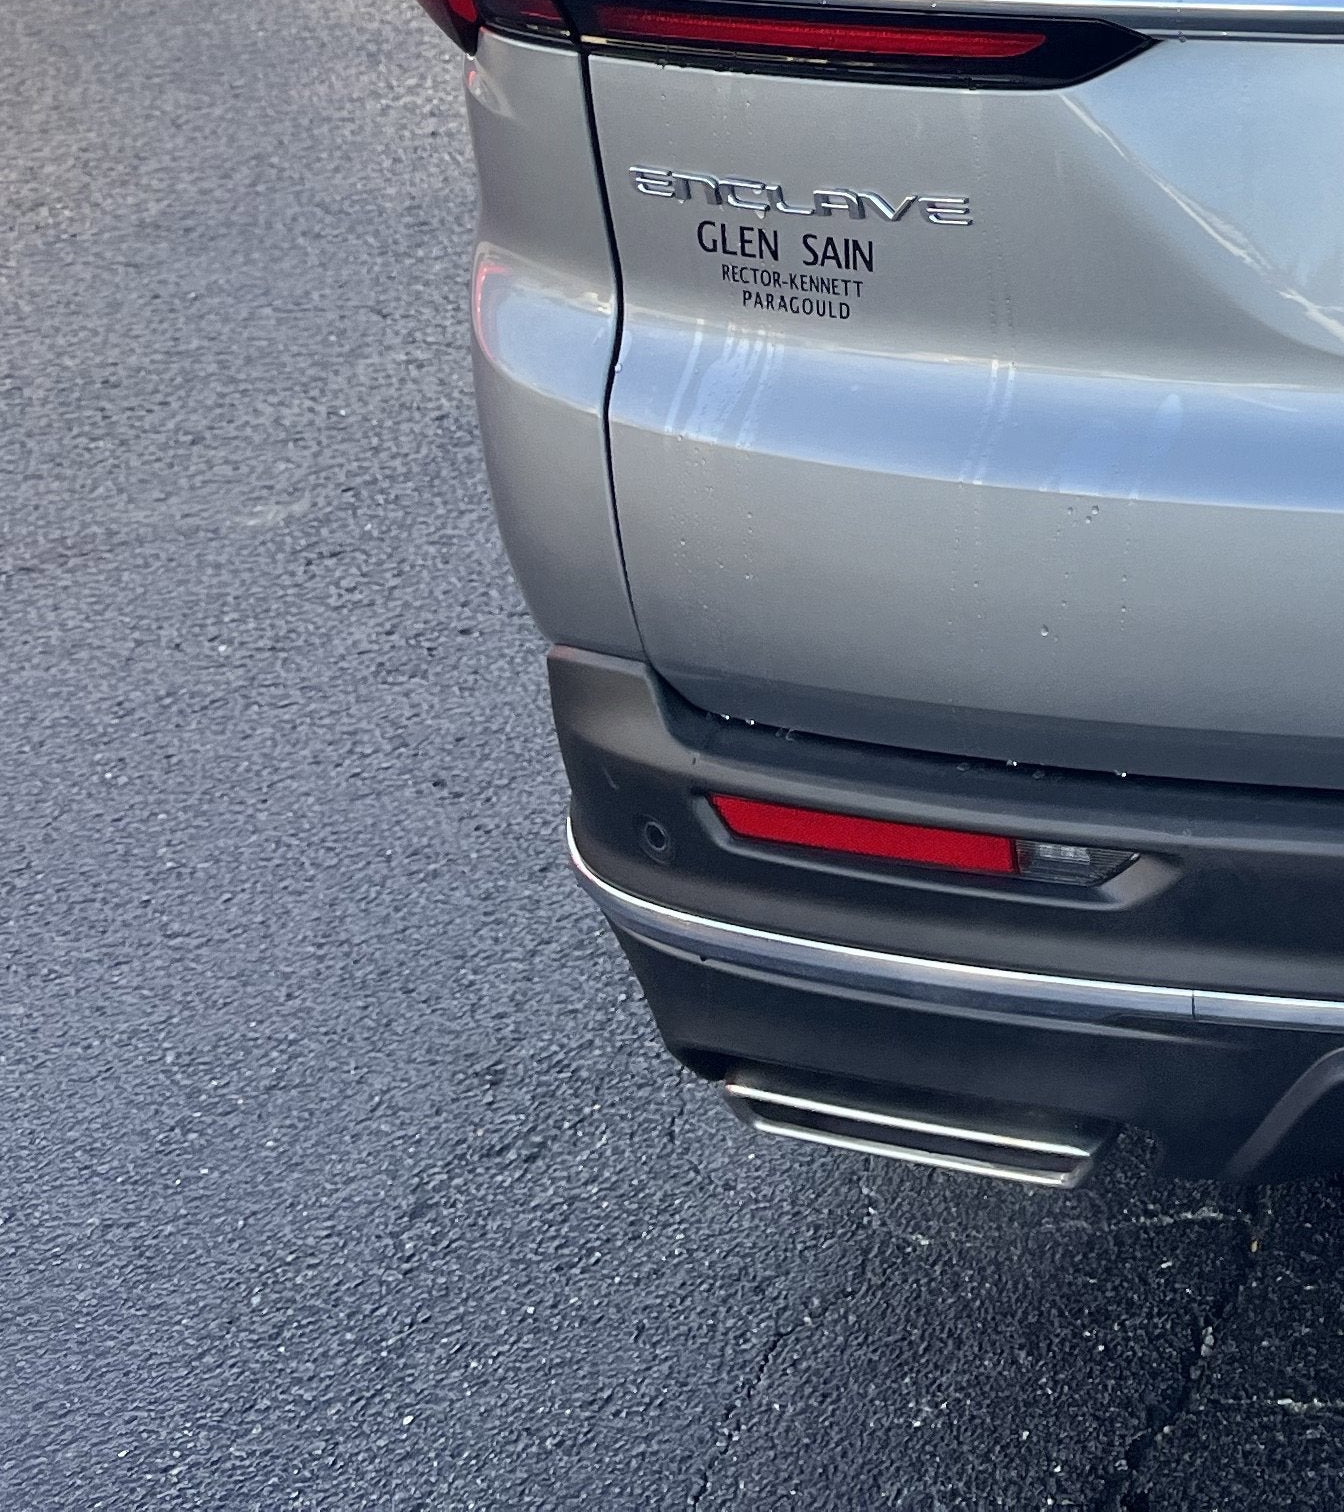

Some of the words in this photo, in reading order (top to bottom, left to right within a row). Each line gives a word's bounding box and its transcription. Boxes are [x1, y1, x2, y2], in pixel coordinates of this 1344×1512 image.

[629, 165, 974, 226] ENCLAVE
[697, 220, 780, 262] GLEN
[802, 233, 874, 273] SAIN
[721, 263, 864, 298] RECTOR-KENNETT
[742, 289, 851, 320] PARAGOULD
